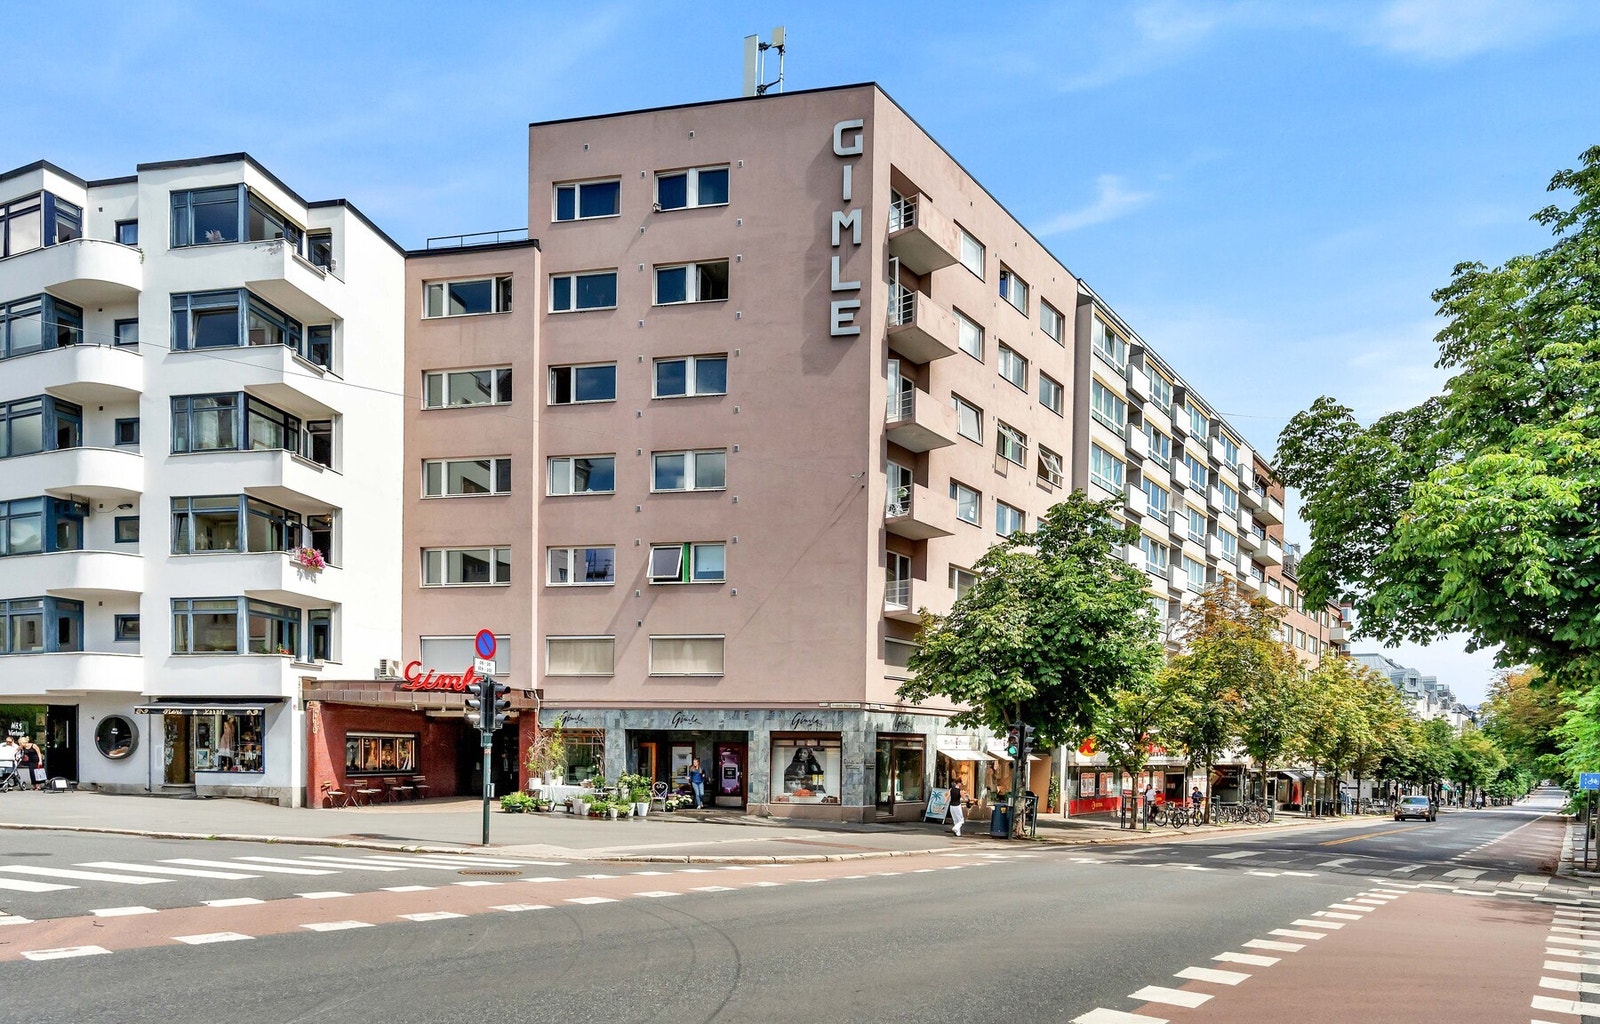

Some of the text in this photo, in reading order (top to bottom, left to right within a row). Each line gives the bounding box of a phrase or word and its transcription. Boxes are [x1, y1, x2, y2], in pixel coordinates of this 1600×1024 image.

[830, 118, 863, 337] GIMLE
[672, 711, 702, 728] Gimle
[791, 712, 822, 730] Gimle
